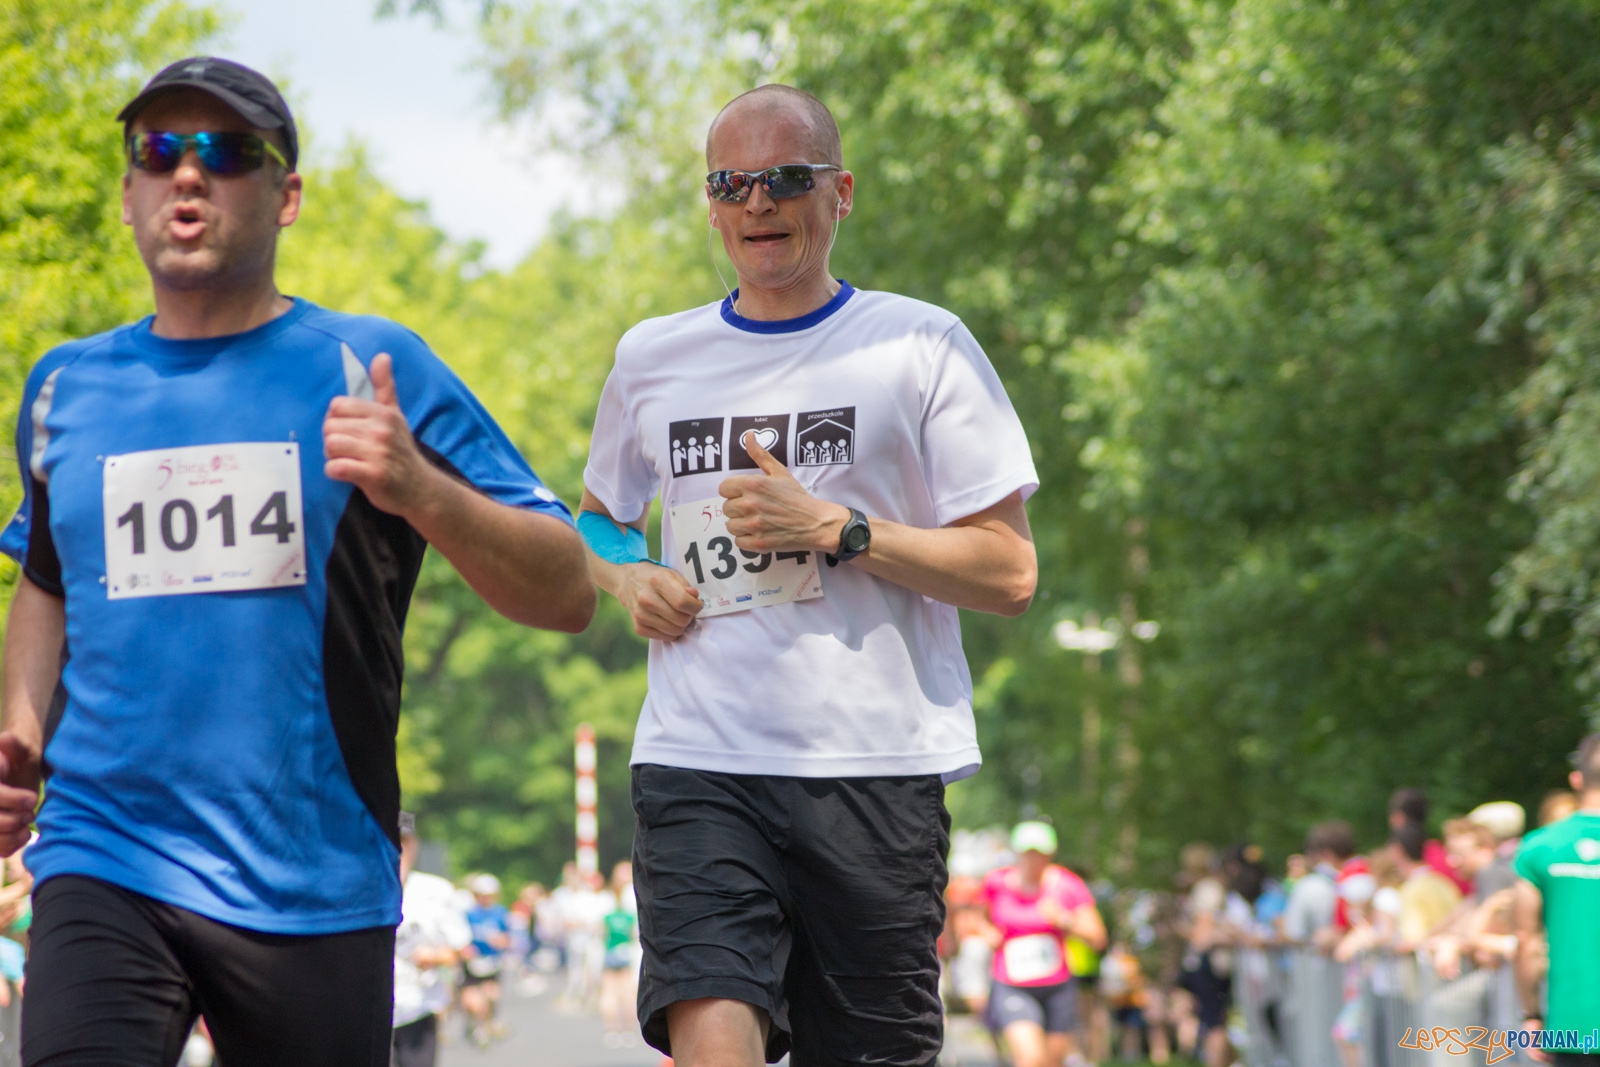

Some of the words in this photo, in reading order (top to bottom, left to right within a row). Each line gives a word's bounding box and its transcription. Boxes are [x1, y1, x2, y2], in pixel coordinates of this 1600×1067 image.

[807, 410, 844, 420] przedszkole
[157, 457, 173, 490] 5
[117, 490, 296, 556] 1014
[701, 504, 713, 532] 5
